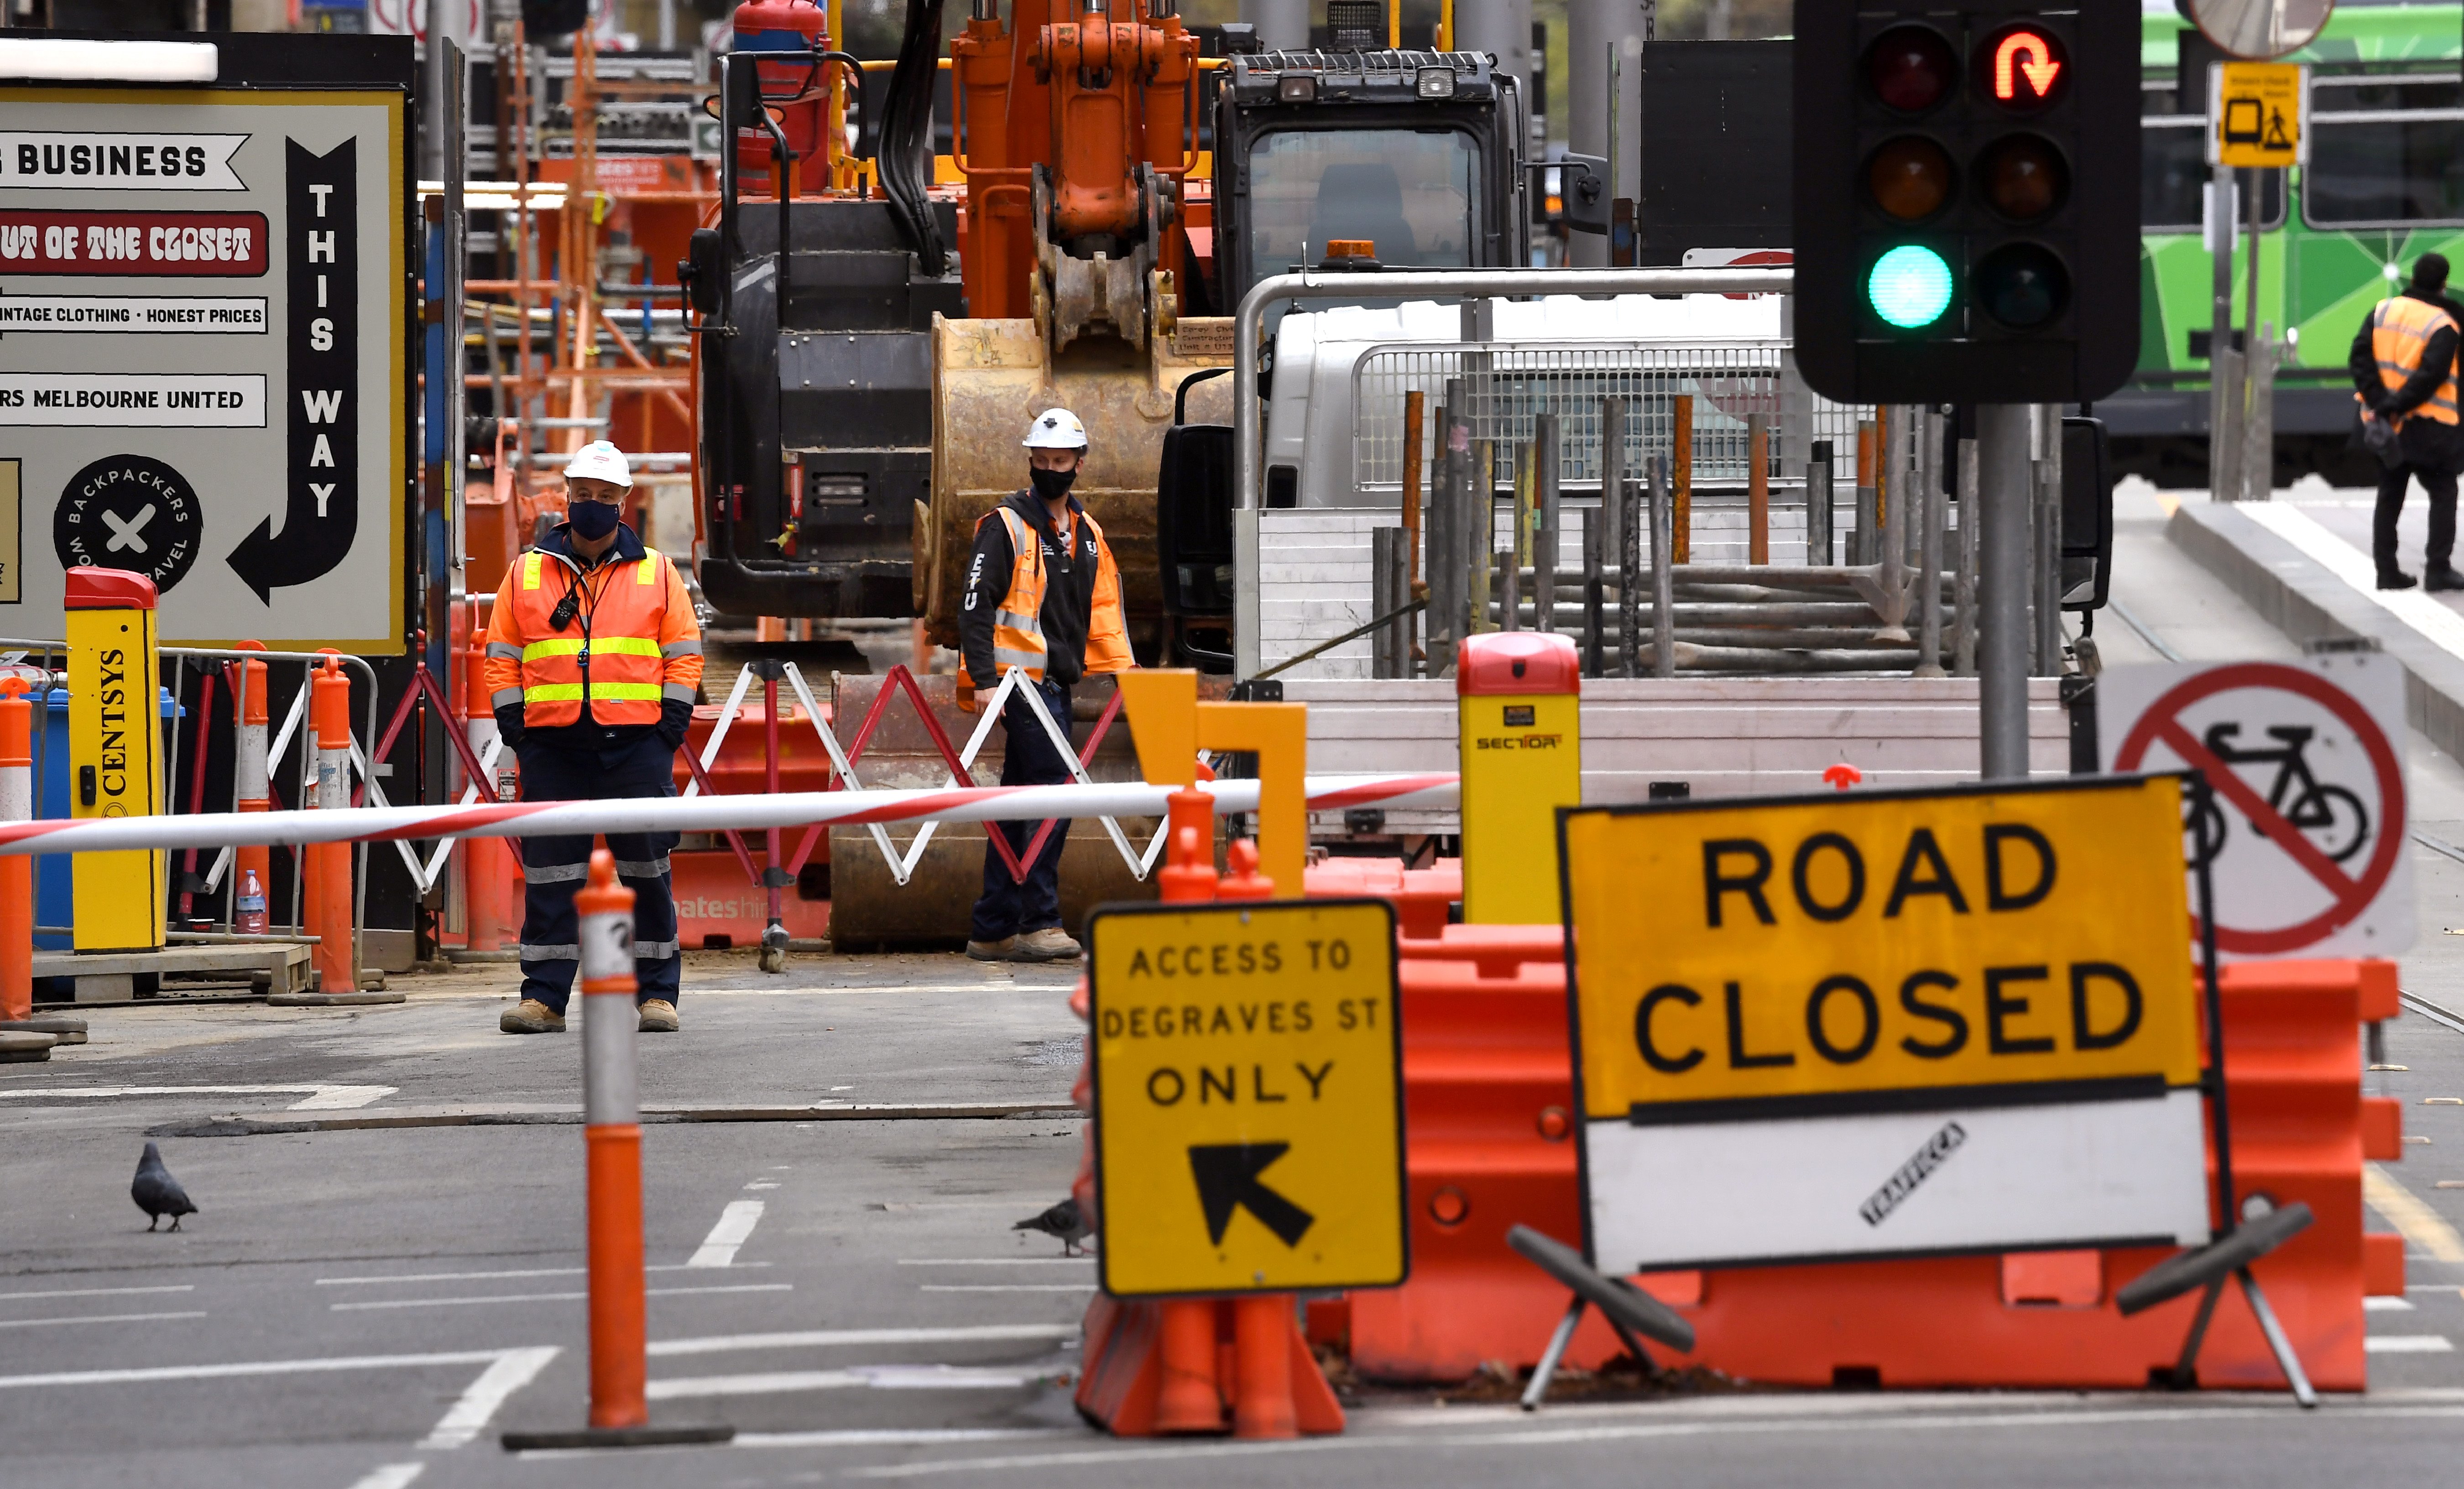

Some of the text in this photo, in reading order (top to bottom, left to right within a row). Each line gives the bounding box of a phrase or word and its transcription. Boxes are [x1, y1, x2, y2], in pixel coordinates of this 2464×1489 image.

[18, 144, 205, 177] BUSINESS
[1, 225, 251, 261] UT OF THE CLOSET
[0, 307, 261, 323] INTAGE CLOTHING HONEST PRICES
[302, 184, 343, 517] THIS WAY
[0, 390, 243, 408] RS MELBOURNE UNITED
[68, 469, 188, 524] BACKPACKERS
[964, 552, 986, 611] ETU
[100, 649, 127, 797] CENTSYS
[1477, 735, 1557, 750] SECTOR
[1702, 822, 2058, 929] ROAD
[673, 896, 738, 918] ates
[1128, 938, 1352, 979] ACCESS TO
[1102, 997, 1379, 1039] DEGRAVES ST
[1634, 960, 2144, 1074] CLOSED
[1146, 1061, 1334, 1108] ONLY
